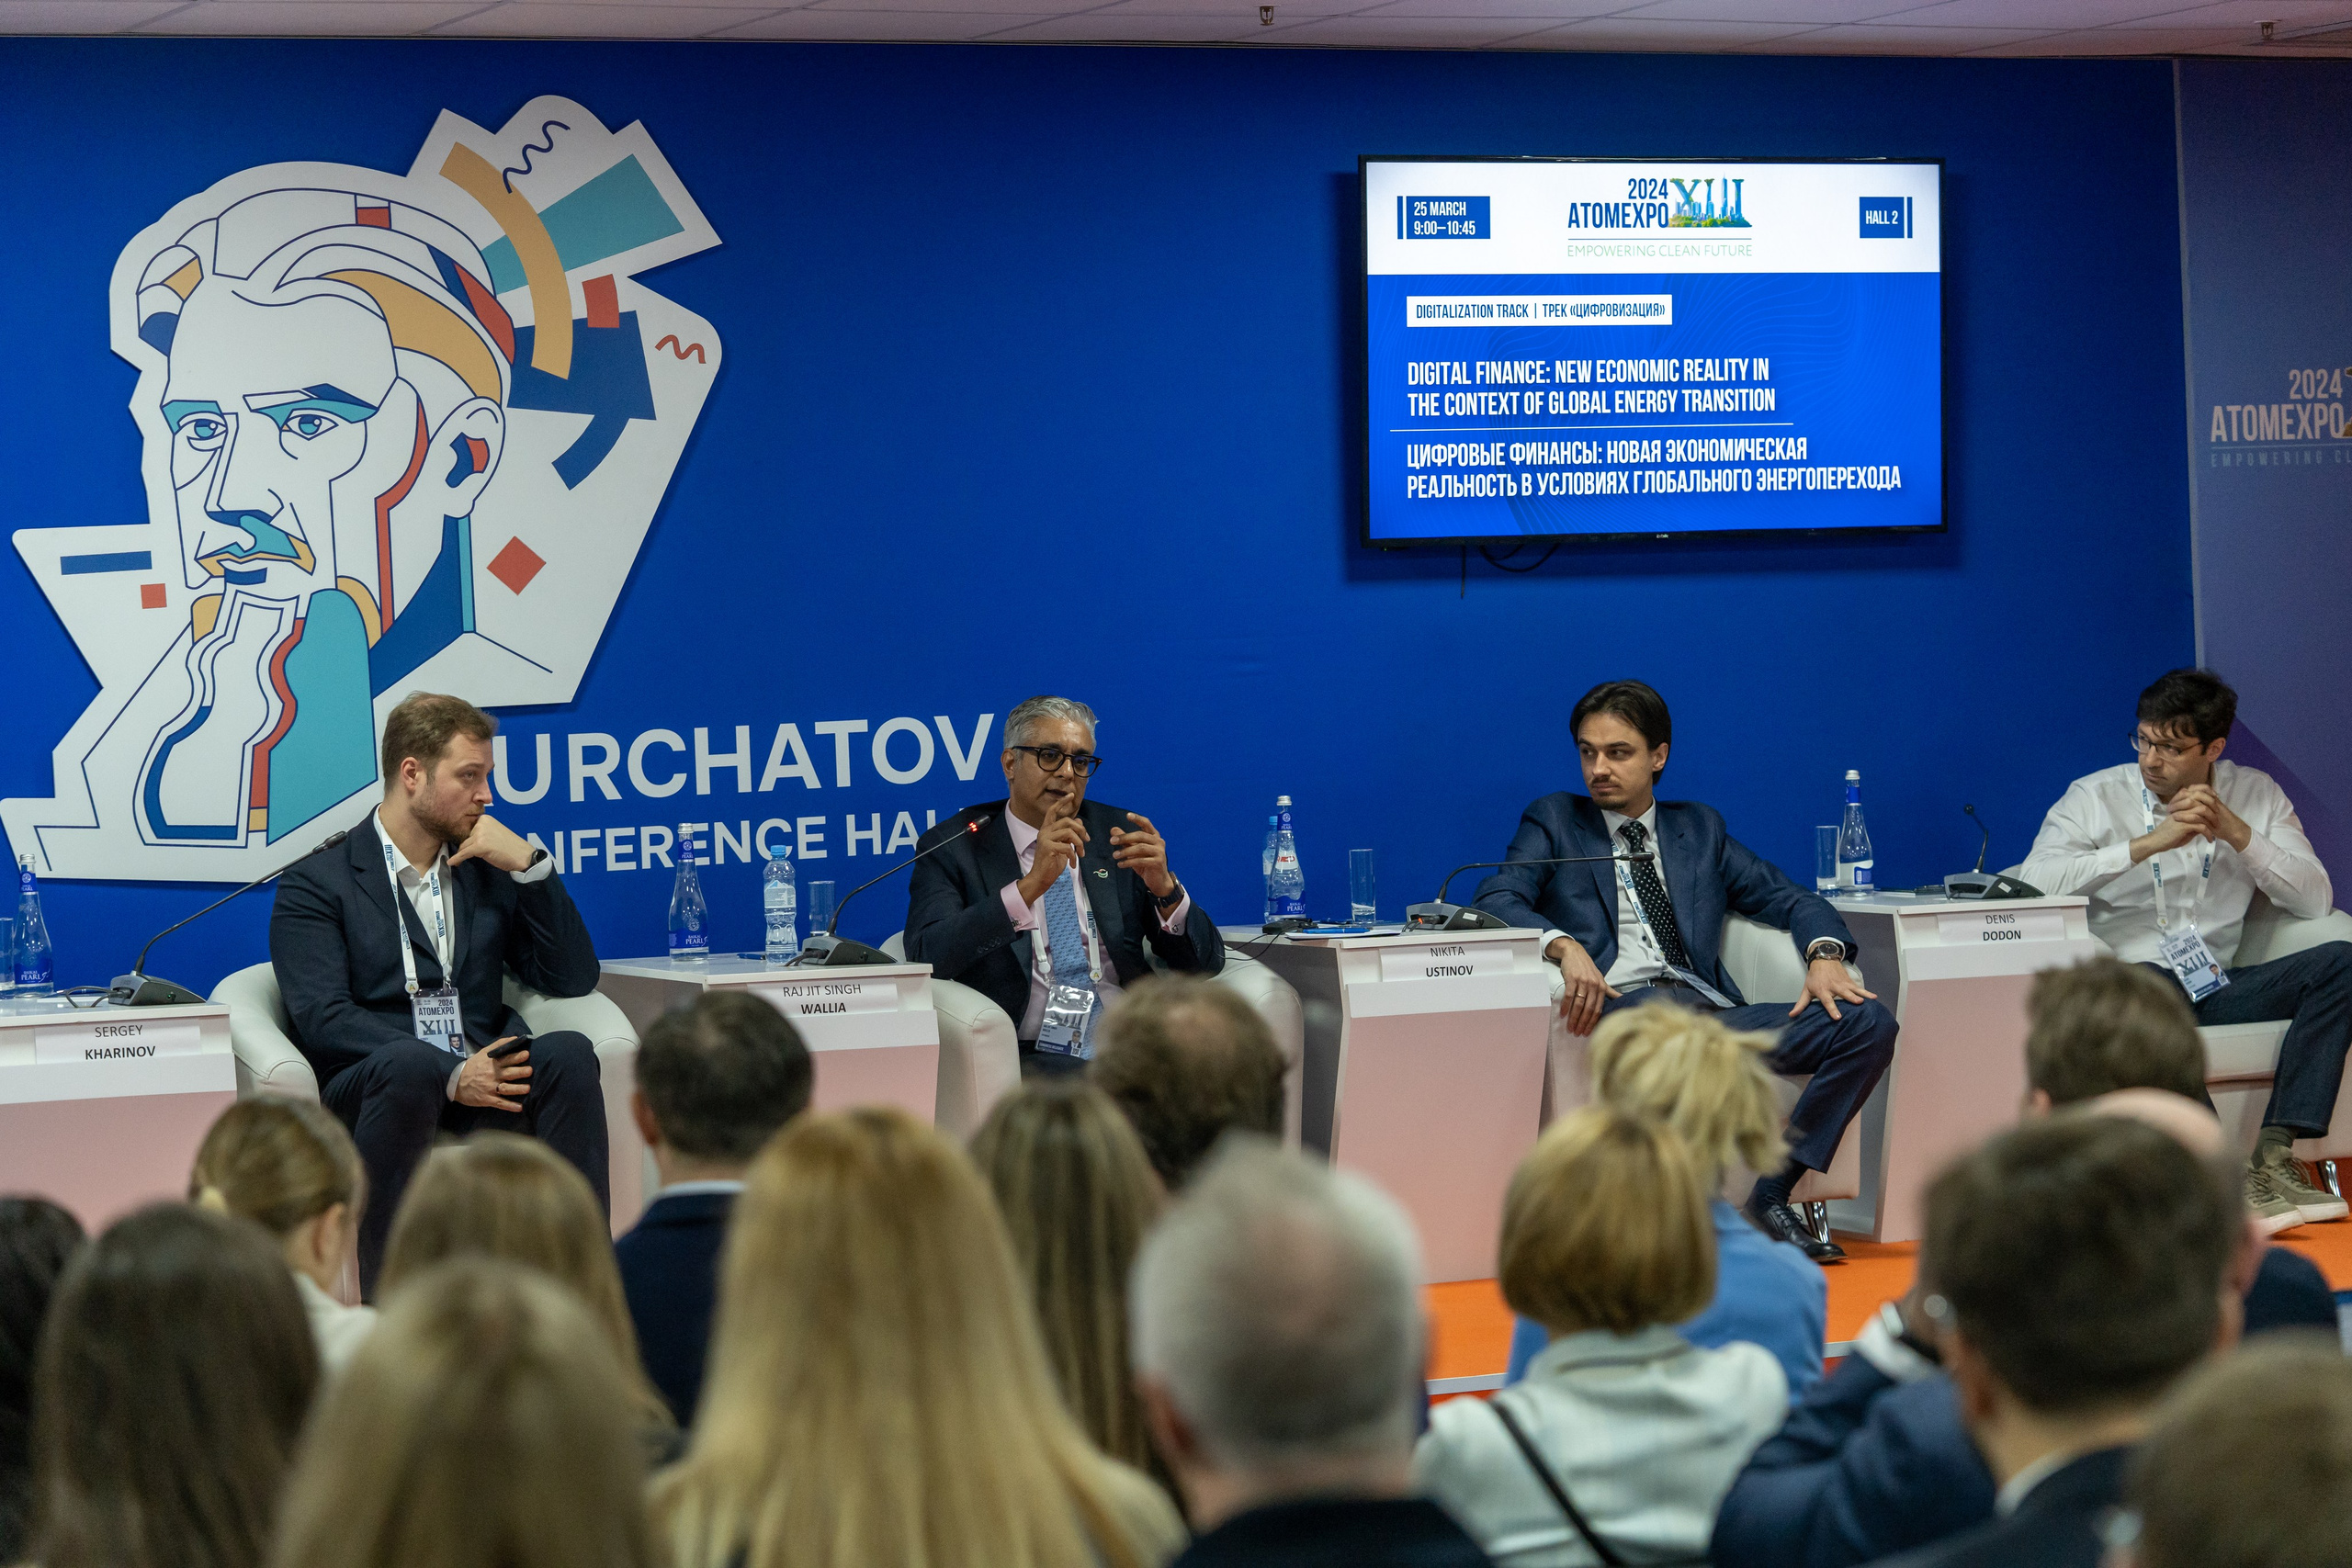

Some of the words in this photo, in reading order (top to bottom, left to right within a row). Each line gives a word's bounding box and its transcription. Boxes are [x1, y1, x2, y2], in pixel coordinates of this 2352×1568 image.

[1627, 177, 1668, 199] 2024
[1414, 201, 1427, 216] 25
[1430, 201, 1466, 216] MARCH
[1567, 202, 1669, 229] ATOMEXPO
[1865, 210, 1890, 225] HALL
[1892, 210, 1898, 225] 2
[1567, 244, 1656, 257] EMPOWERING
[1658, 244, 1700, 257] CLEAN
[1704, 244, 1753, 257] FUTURE
[1416, 304, 1493, 319] DIGITALIZATION
[1497, 303, 1529, 318] TRACK
[1542, 303, 1566, 318] ТРЕК
[1570, 302, 1666, 319] «ЦИФРОВИЗАЦИЯ»
[1408, 361, 1472, 386] DIGITAL
[1476, 360, 1551, 384] FINANCE:
[1555, 359, 1592, 383] NEW
[1596, 358, 1679, 383] ECONOMIC
[1683, 358, 1749, 382] REALITY
[1753, 357, 1770, 381] IN
[2289, 368, 2343, 400] 2024
[1408, 392, 1440, 416] THE
[1444, 391, 1520, 416] CONTEXT
[1523, 390, 1544, 414] OF
[1548, 390, 1611, 414] GLOBAL
[1614, 389, 1678, 413] ENERGY
[1681, 388, 1775, 412] TRANSITION
[2211, 402, 2344, 442] ATOMEXPO
[1407, 443, 1506, 469] ЦИФРОВЫЕ
[1510, 441, 1602, 466] ФИНАНСЫ:
[1607, 439, 1661, 464] НОВАЯ
[1666, 437, 1807, 463] ЭКОНОМИЧЕСКАЯ
[1407, 473, 1517, 499] РЕАЛЬНОСТЬ
[1521, 472, 1532, 497] В
[1536, 470, 1629, 496] УСЛОВИЯХ
[1634, 468, 1752, 494] ГЛОБАЛЬНОГО
[1757, 466, 1902, 491] ЭНЕРГОПЕРЕХОДА
[484, 713, 995, 807] URCHATOV
[526, 816, 828, 874] NFERENCE
[1985, 913, 2016, 924] DENIS
[1983, 930, 2021, 942] DODON
[1430, 946, 1465, 957] NIKITA
[2170, 941, 2201, 961] ATOMEXPO
[1425, 964, 1474, 977] USTINOV
[783, 986, 804, 998] RAJ
[806, 985, 821, 998] JIT
[824, 983, 862, 996] SINGH
[437, 998, 454, 1007] 2024
[800, 1002, 847, 1015] WALLIA
[418, 1006, 455, 1016] ATOMEXPO
[95, 1024, 143, 1038] SERGEY
[85, 1045, 156, 1060] KHARINOV
